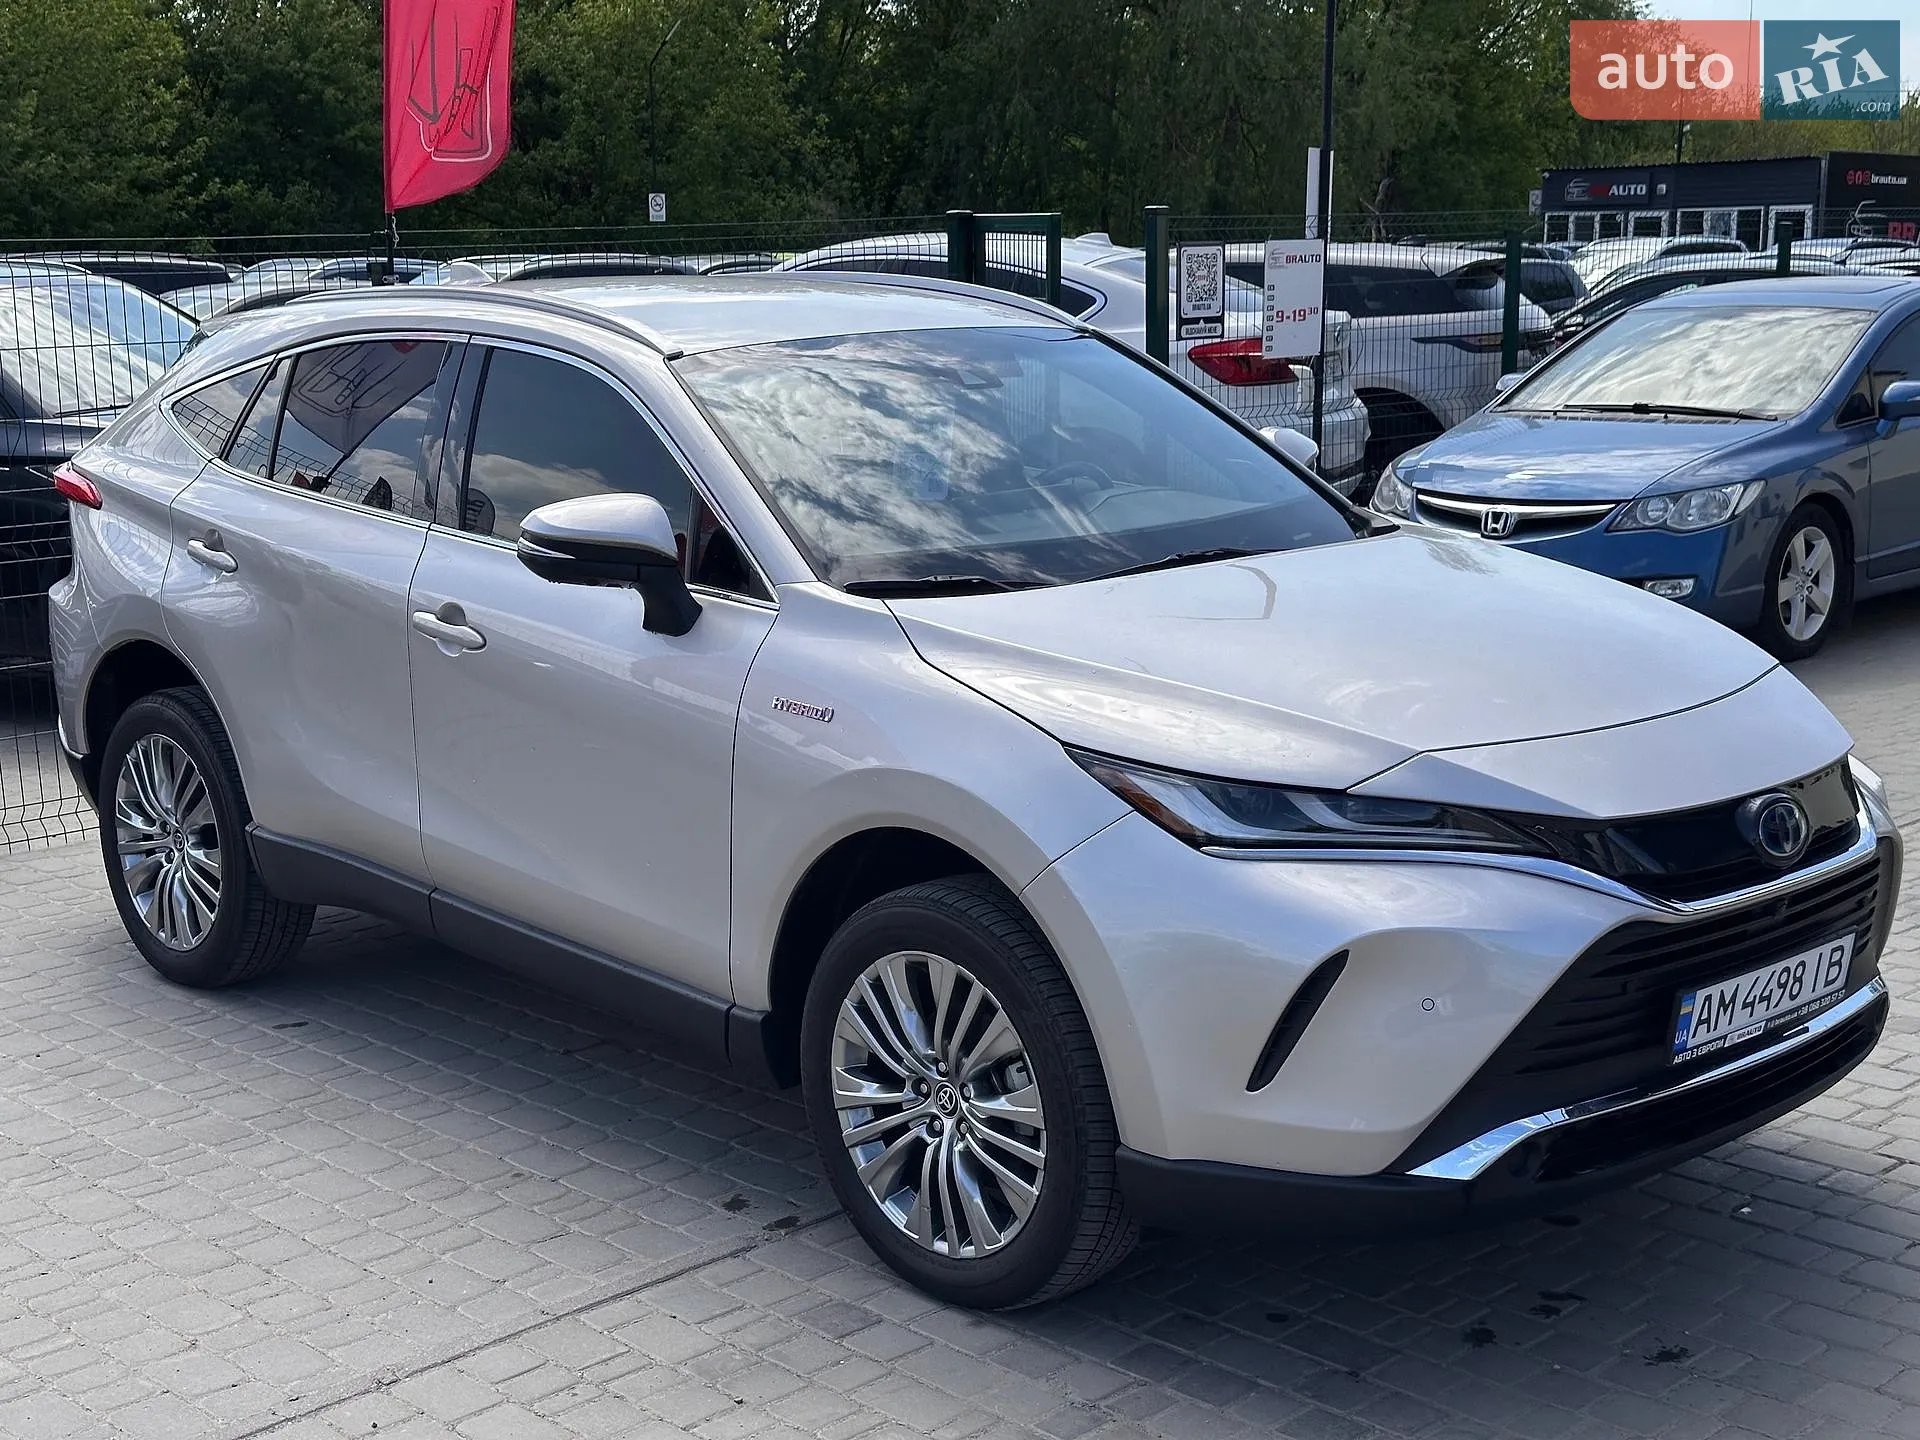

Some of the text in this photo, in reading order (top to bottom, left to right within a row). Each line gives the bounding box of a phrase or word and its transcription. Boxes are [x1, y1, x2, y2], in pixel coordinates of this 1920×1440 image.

[1871, 173, 1907, 185] brauto.ua
[1285, 254, 1321, 264] BRAUTO
[771, 696, 823, 721] HYBRID
[1691, 944, 1845, 1039] AM 4498 IB
[1674, 1028, 1688, 1044] UA
